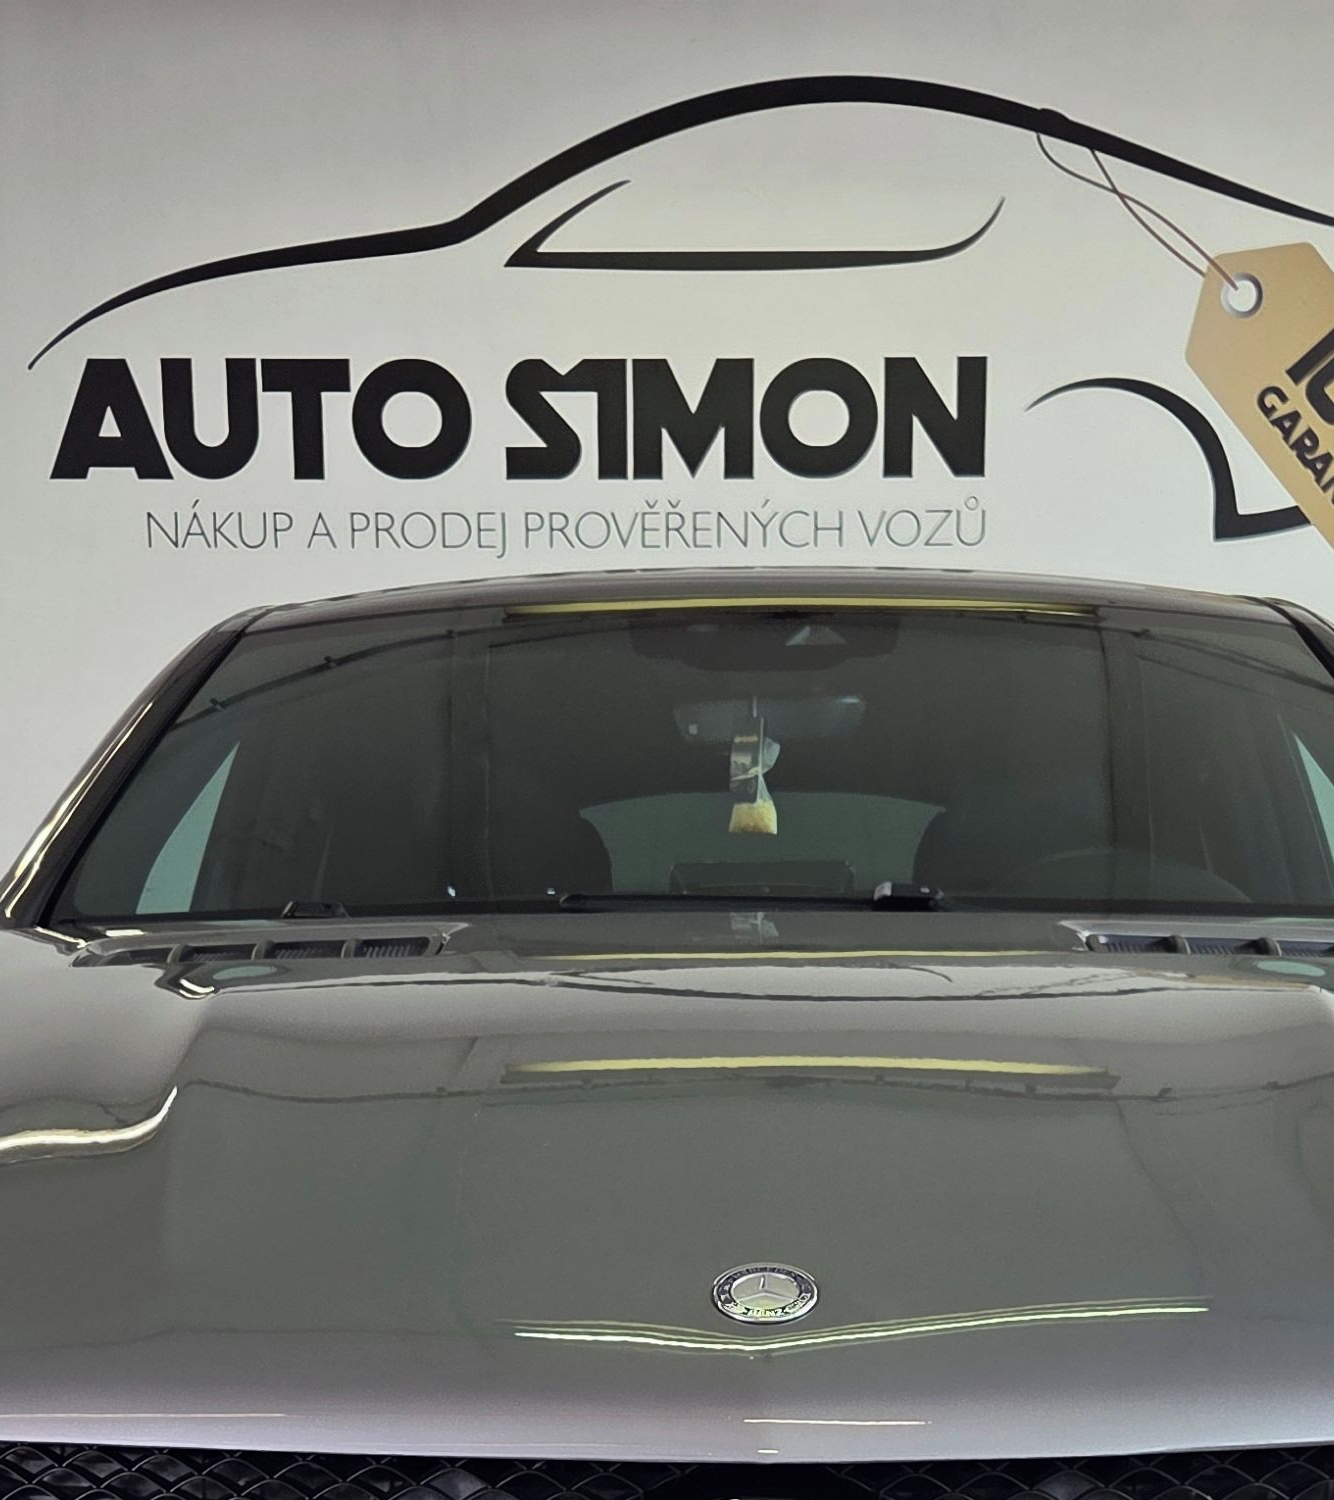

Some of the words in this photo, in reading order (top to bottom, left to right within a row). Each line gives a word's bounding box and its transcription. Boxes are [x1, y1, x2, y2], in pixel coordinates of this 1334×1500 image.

[49, 356, 472, 480] AUTO
[505, 355, 988, 480] SIMON
[146, 498, 294, 550] NÁKUP
[306, 511, 338, 549] A
[349, 511, 507, 557] PRODEJ
[524, 498, 844, 549] PROVĚŘENÝCH
[858, 495, 986, 548] VOZŮ
